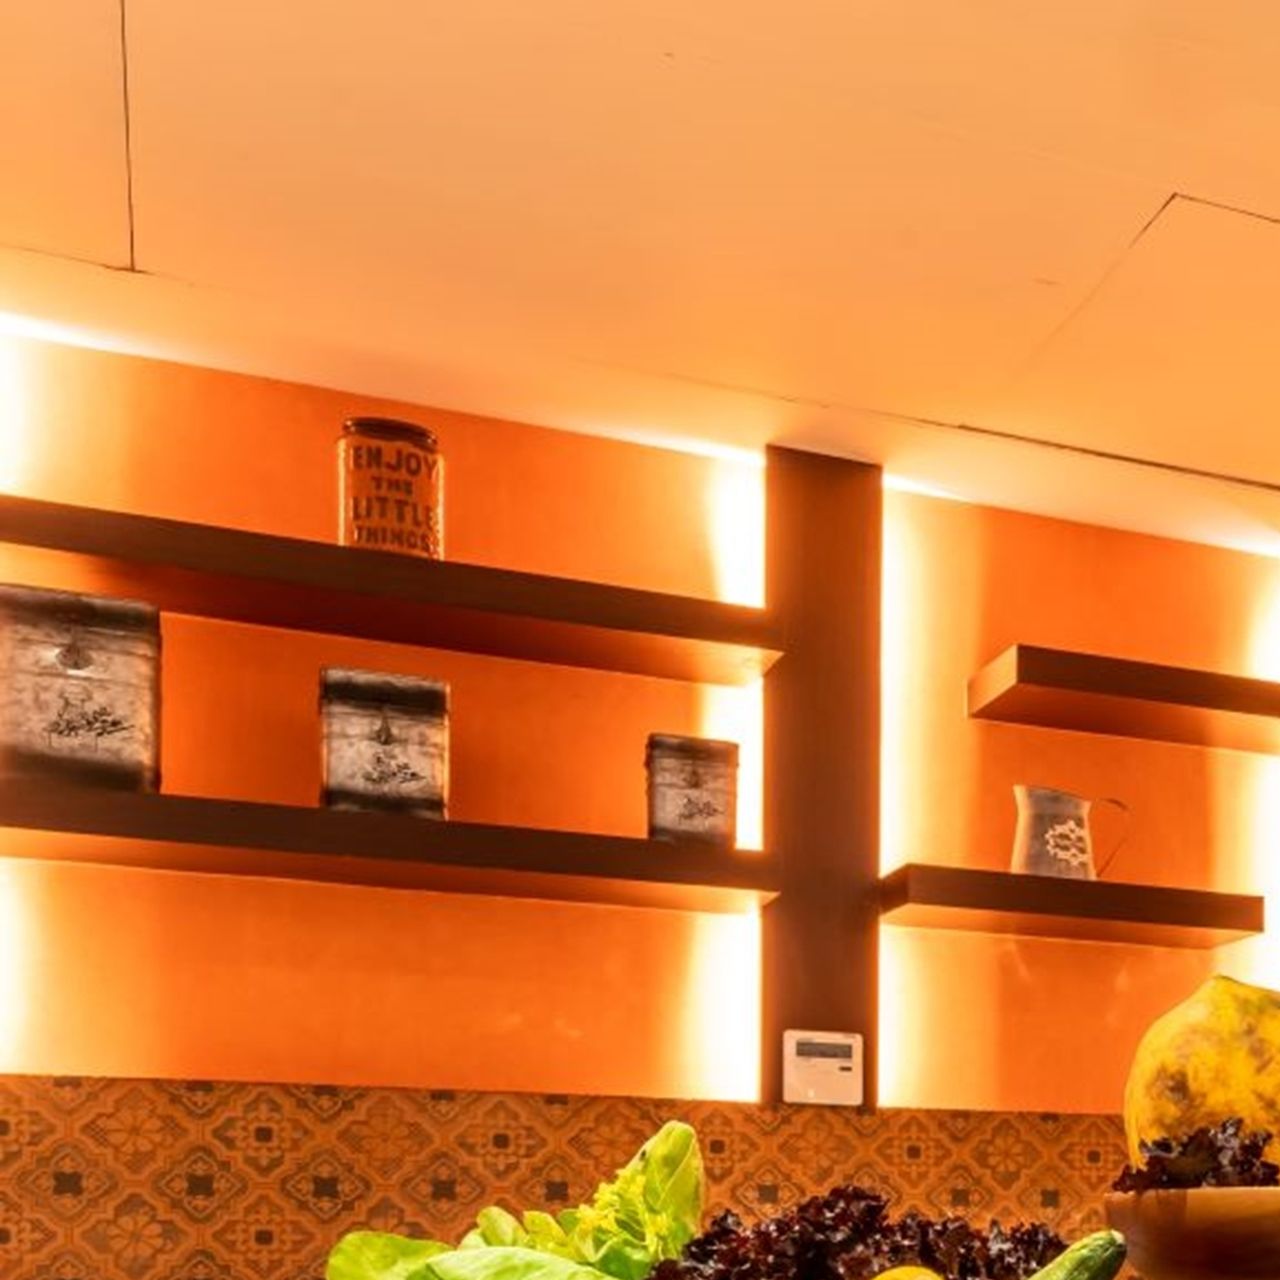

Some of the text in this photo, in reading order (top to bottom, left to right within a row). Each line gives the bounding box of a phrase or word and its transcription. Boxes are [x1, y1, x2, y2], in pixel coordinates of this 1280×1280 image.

[352, 446, 437, 479] ENJOY
[371, 477, 413, 494] THE
[352, 496, 434, 530] LITTLE
[354, 525, 432, 552] THINGS
